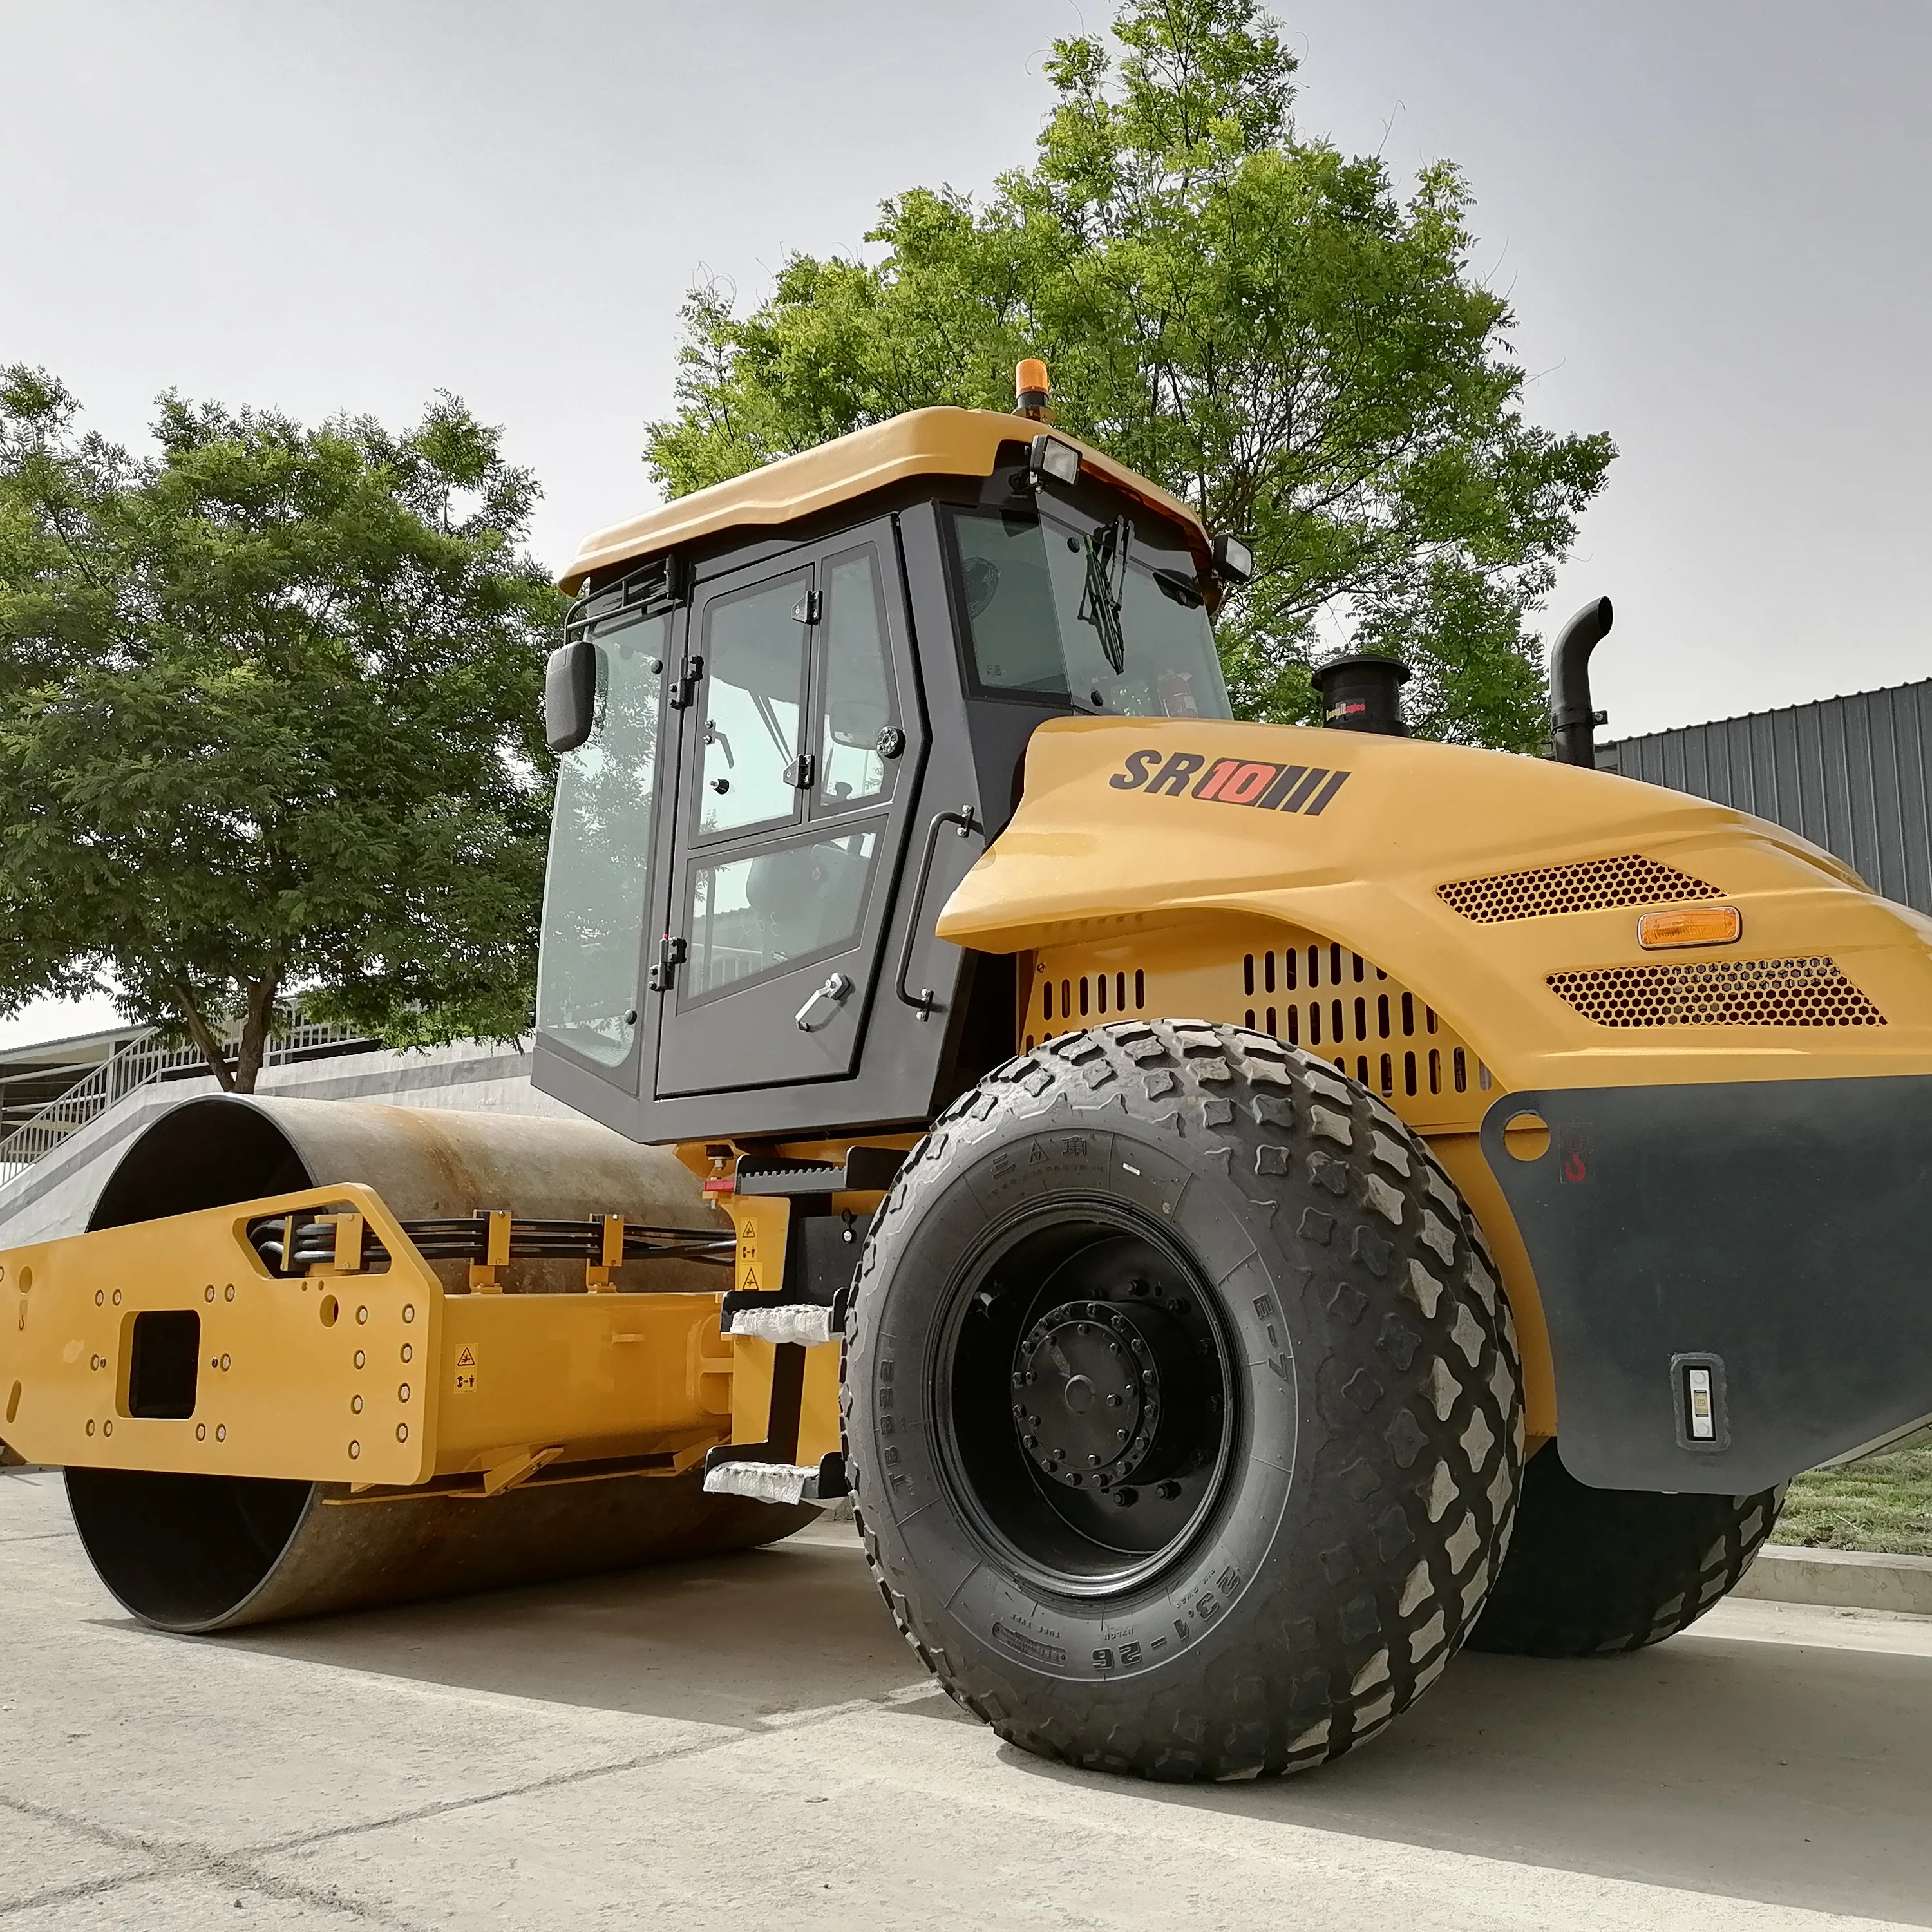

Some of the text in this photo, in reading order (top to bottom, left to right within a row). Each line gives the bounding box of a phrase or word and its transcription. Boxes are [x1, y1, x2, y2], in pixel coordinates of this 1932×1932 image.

[1252, 1291, 1288, 1381] E-7
[879, 1359, 904, 1495] TB822
[1092, 1564, 1240, 1671] 23.1-26
